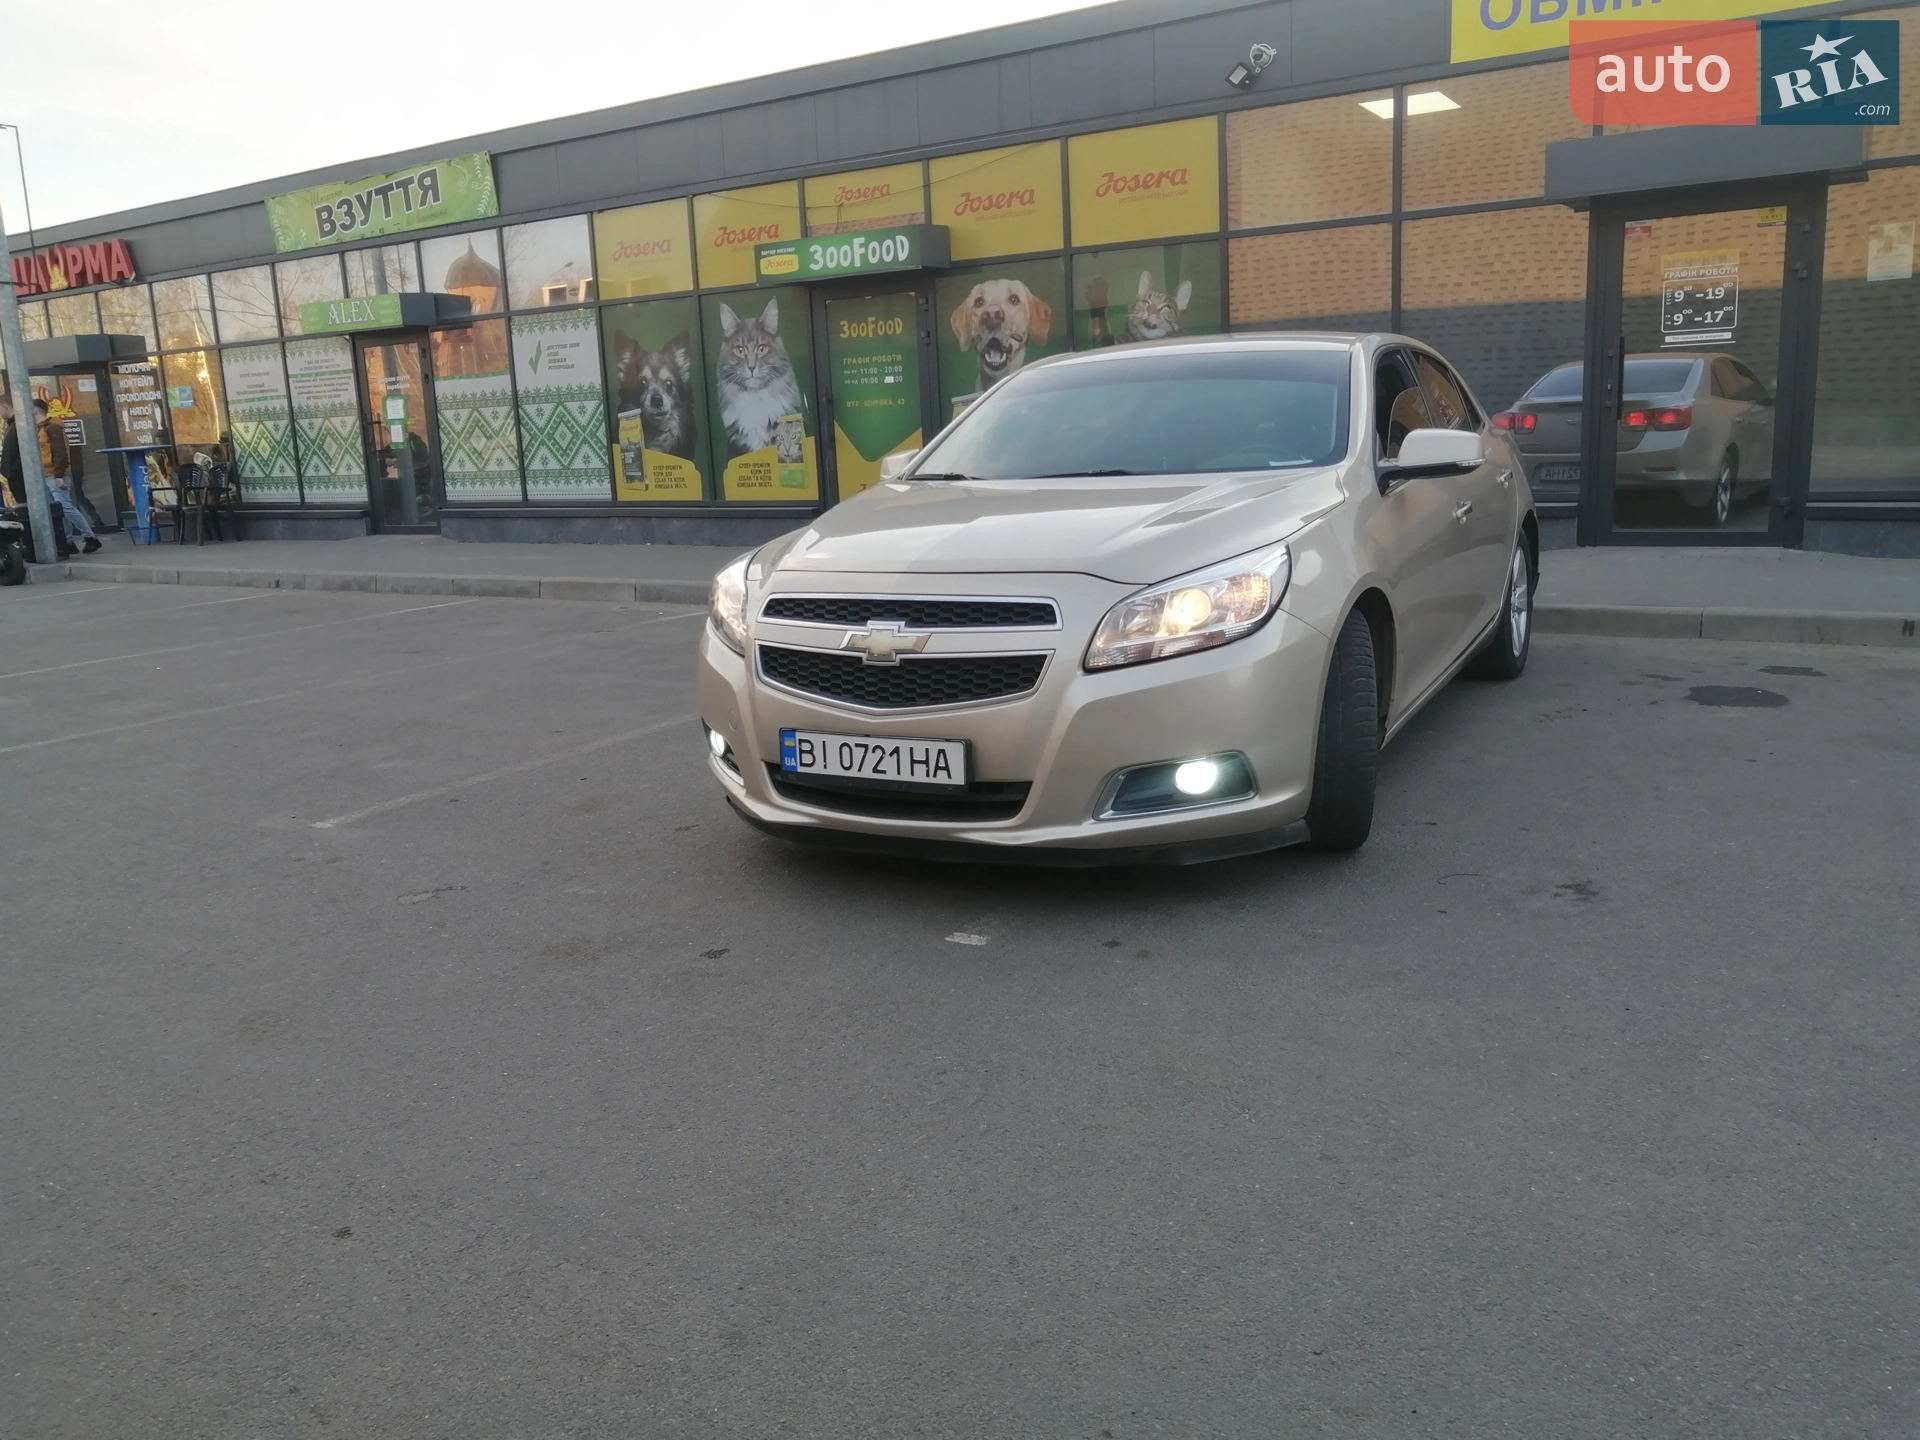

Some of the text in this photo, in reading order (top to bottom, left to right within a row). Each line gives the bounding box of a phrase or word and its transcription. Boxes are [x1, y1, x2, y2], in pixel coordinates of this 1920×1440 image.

[1095, 167, 1188, 198] Josera
[834, 183, 892, 204] Josera
[1118, 188, 1188, 205] petfood with passion
[314, 167, 442, 241] ВЗУТТЯ
[953, 188, 1036, 217] Josera
[714, 224, 780, 247] Josera
[613, 239, 672, 261] Josera
[764, 259, 794, 270] Josera
[1664, 266, 1738, 279] ГРАФІК РОБОТИ
[327, 299, 376, 325] ALEX
[843, 354, 902, 365] ГРАФІК РОБОТИ
[860, 366, 878, 375] 11:00
[884, 365, 903, 373] 20:00
[118, 375, 154, 388] КОКТЕЙЛІ
[116, 390, 162, 403] ПРОХОЛОДНІ
[129, 403, 153, 416] НАПОЇ
[132, 420, 153, 430] КАВА
[137, 432, 153, 444] ЧАЙ
[784, 757, 796, 767] UA
[798, 737, 952, 779] BI 0721 HA
